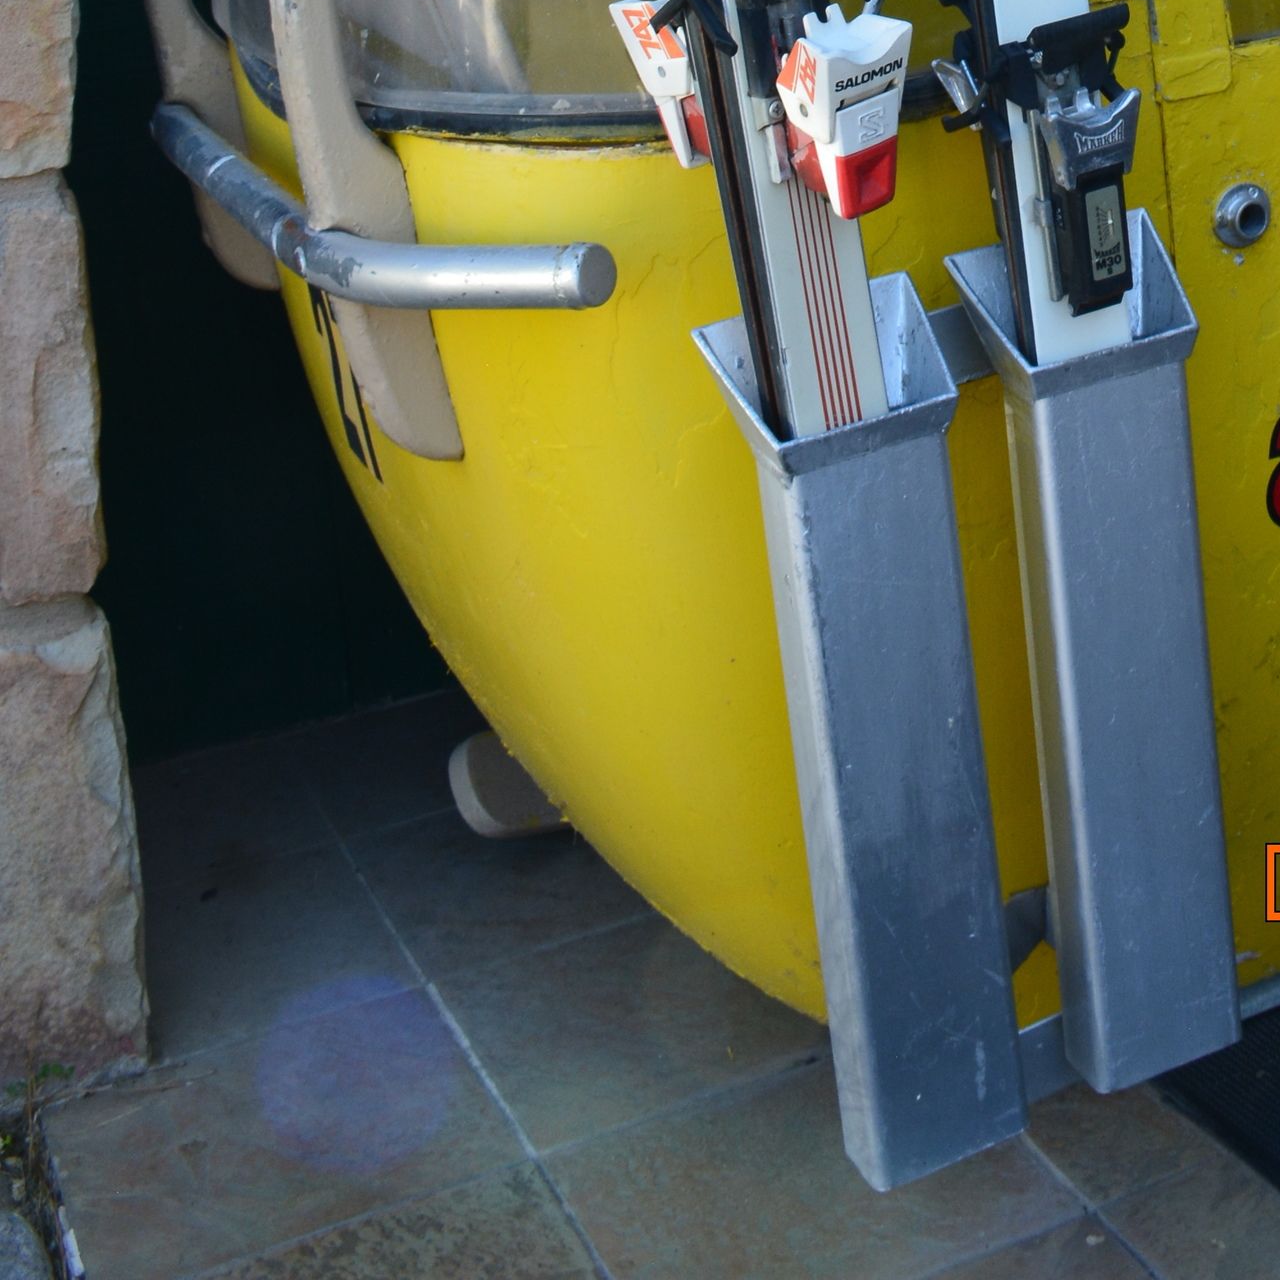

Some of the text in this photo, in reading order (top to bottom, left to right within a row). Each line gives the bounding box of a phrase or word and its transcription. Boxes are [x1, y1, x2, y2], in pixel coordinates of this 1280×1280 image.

[622, 9, 662, 59] 747
[835, 57, 903, 92] SALOMON
[1096, 254, 1122, 271] M30
